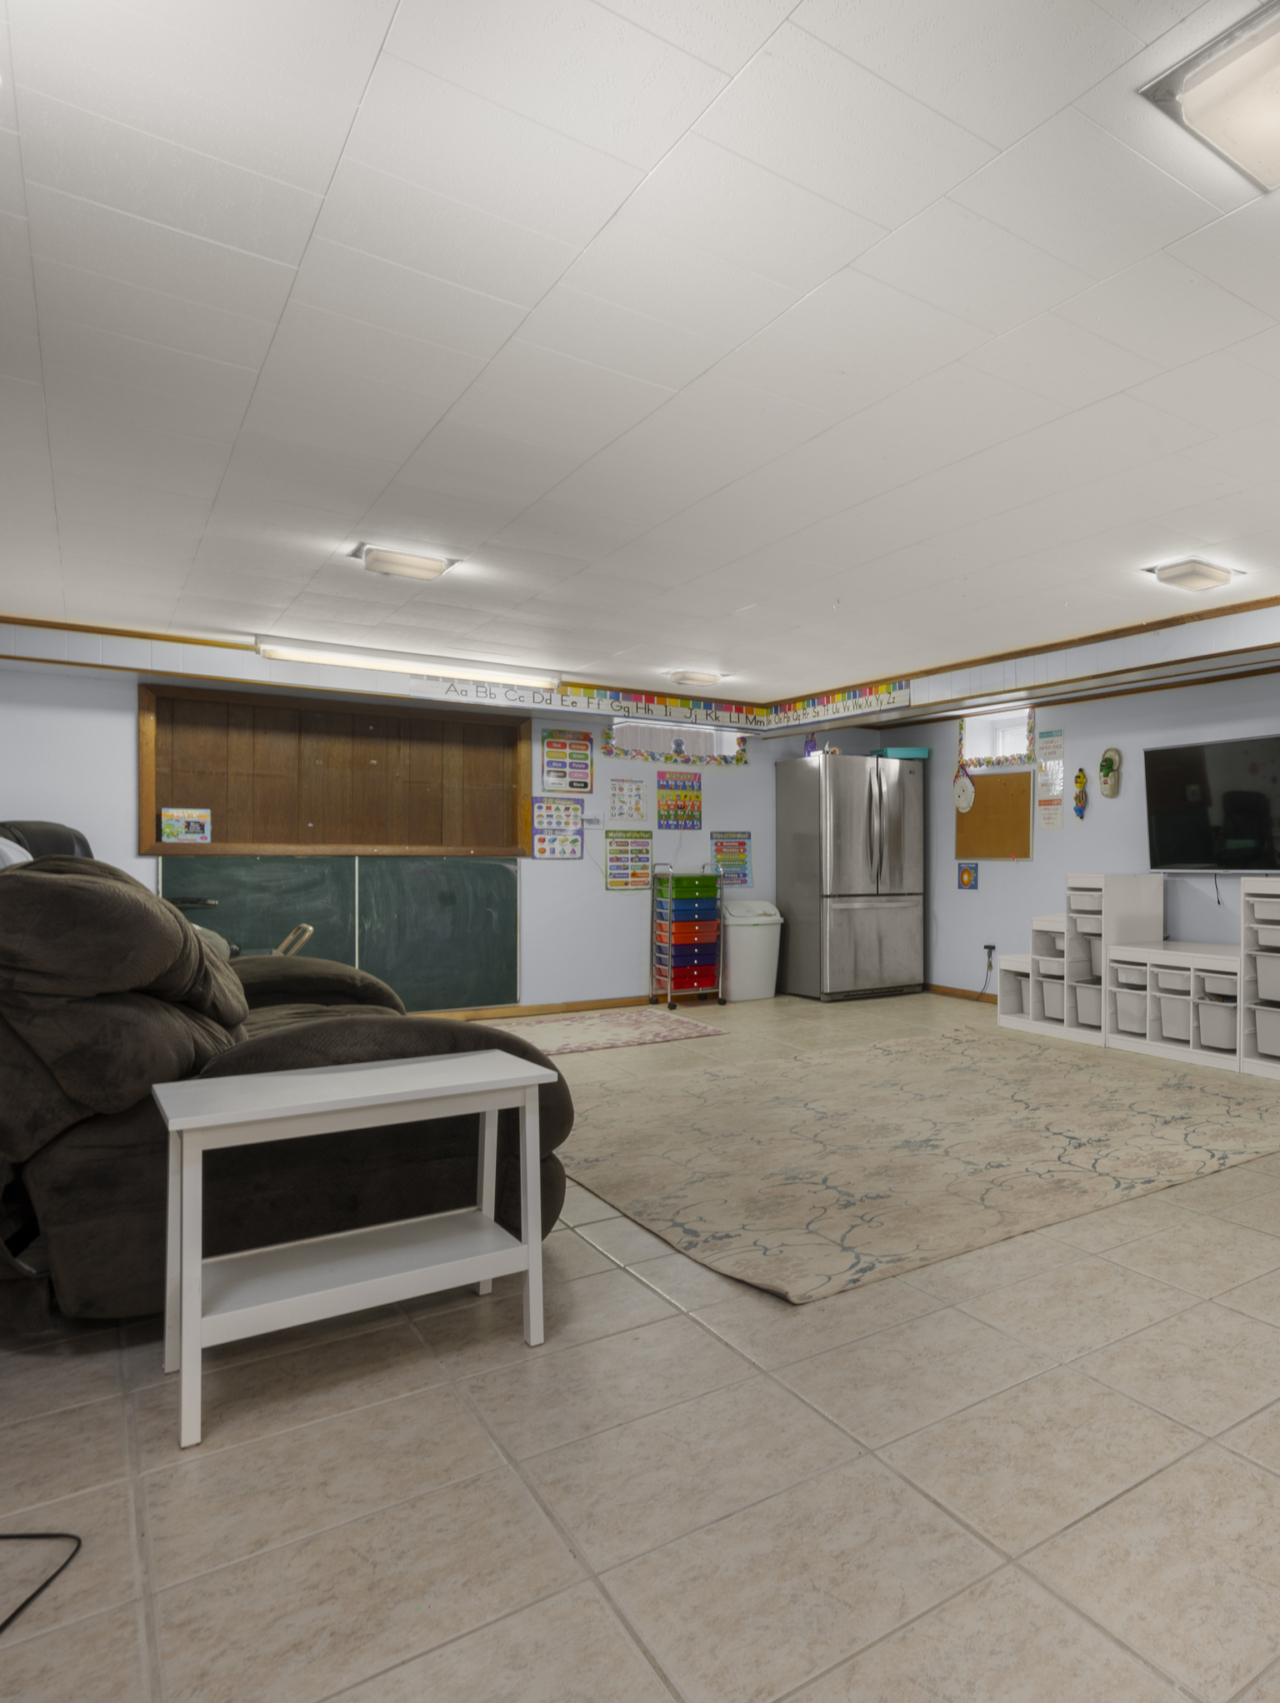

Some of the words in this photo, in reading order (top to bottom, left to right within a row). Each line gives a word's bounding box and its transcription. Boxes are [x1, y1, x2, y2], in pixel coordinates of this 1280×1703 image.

[445, 683, 468, 697] Aa
[475, 685, 497, 699] Bb
[504, 689, 525, 702] Cc
[532, 691, 552, 705] Dd
[560, 694, 578, 708] Ee
[587, 697, 604, 710] Ff
[610, 701, 631, 717] Gg
[635, 703, 653, 715] Hh
[664, 705, 672, 717] Ii
[684, 708, 698, 724] Jj
[705, 710, 721, 722] Kk
[745, 714, 765, 727] Mm
[874, 694, 884, 710] Yy
[886, 692, 896, 705] Zz
